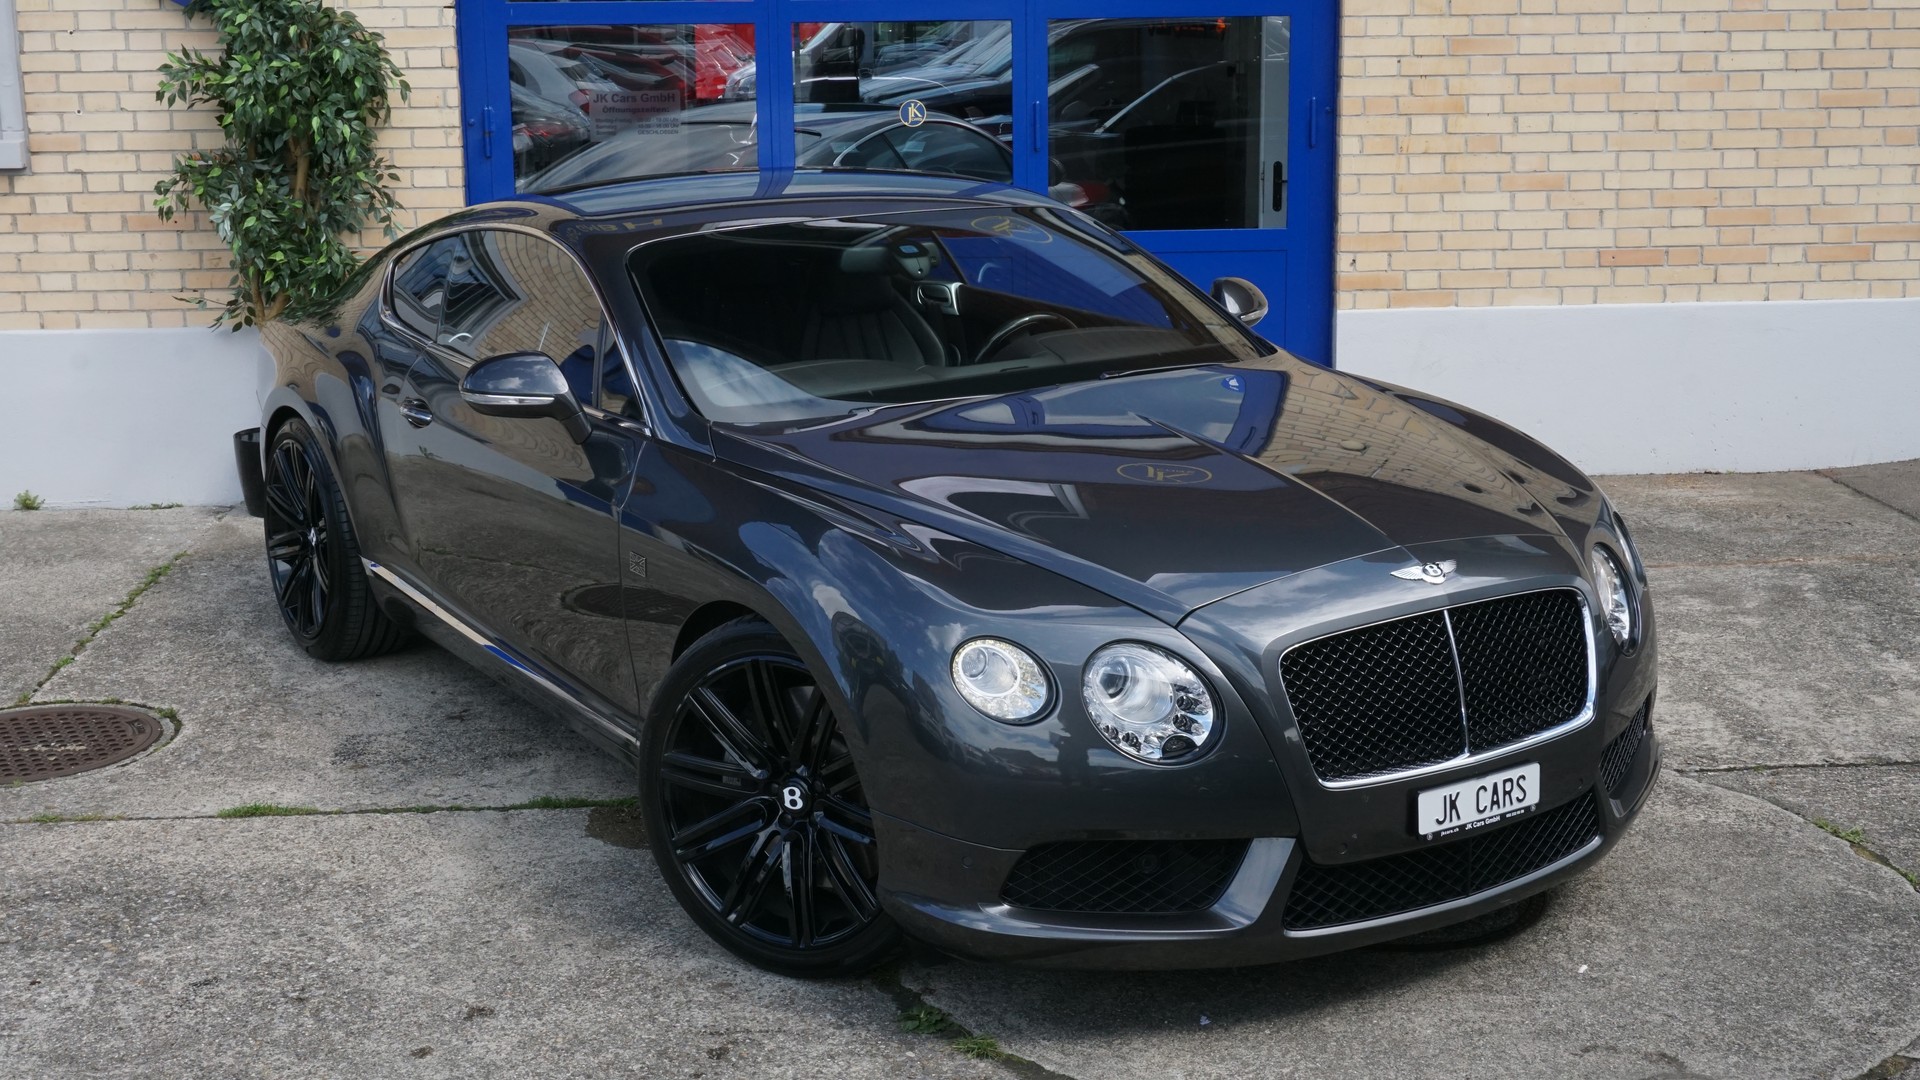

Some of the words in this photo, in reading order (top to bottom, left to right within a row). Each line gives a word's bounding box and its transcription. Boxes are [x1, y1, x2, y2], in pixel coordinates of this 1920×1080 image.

[593, 93, 608, 103] JK
[611, 93, 637, 103] Cars
[640, 93, 675, 103] GmbH
[602, 106, 670, 115] Öffnungszeiten:
[783, 786, 803, 810] B
[1435, 791, 1461, 825] JK
[1476, 774, 1527, 814] CARS
[1465, 823, 1473, 831] JK
[1485, 815, 1501, 825] GmbH
